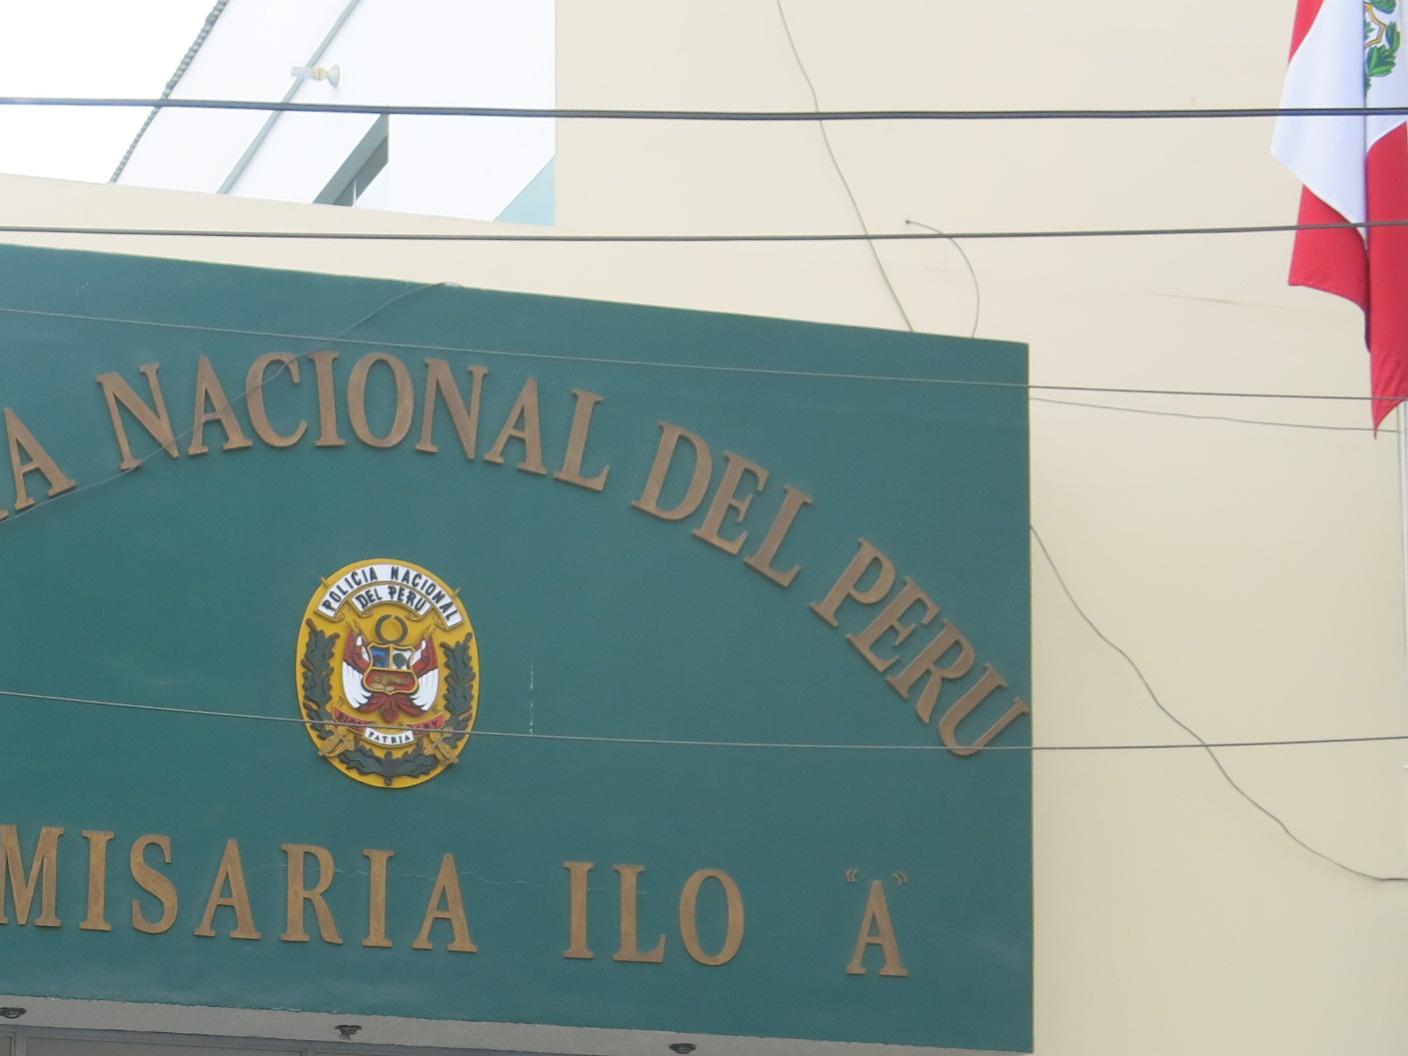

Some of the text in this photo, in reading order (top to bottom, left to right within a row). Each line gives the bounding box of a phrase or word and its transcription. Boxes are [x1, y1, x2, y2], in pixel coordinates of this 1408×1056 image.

[95, 350, 611, 492] NACIONAL
[630, 419, 813, 588] DEL
[809, 537, 1030, 758] PERU
[322, 565, 459, 622] POLICIA NACIONAL
[355, 585, 426, 612] DEL PERU
[368, 730, 411, 744] PATRIA
[563, 861, 746, 966] ILO
